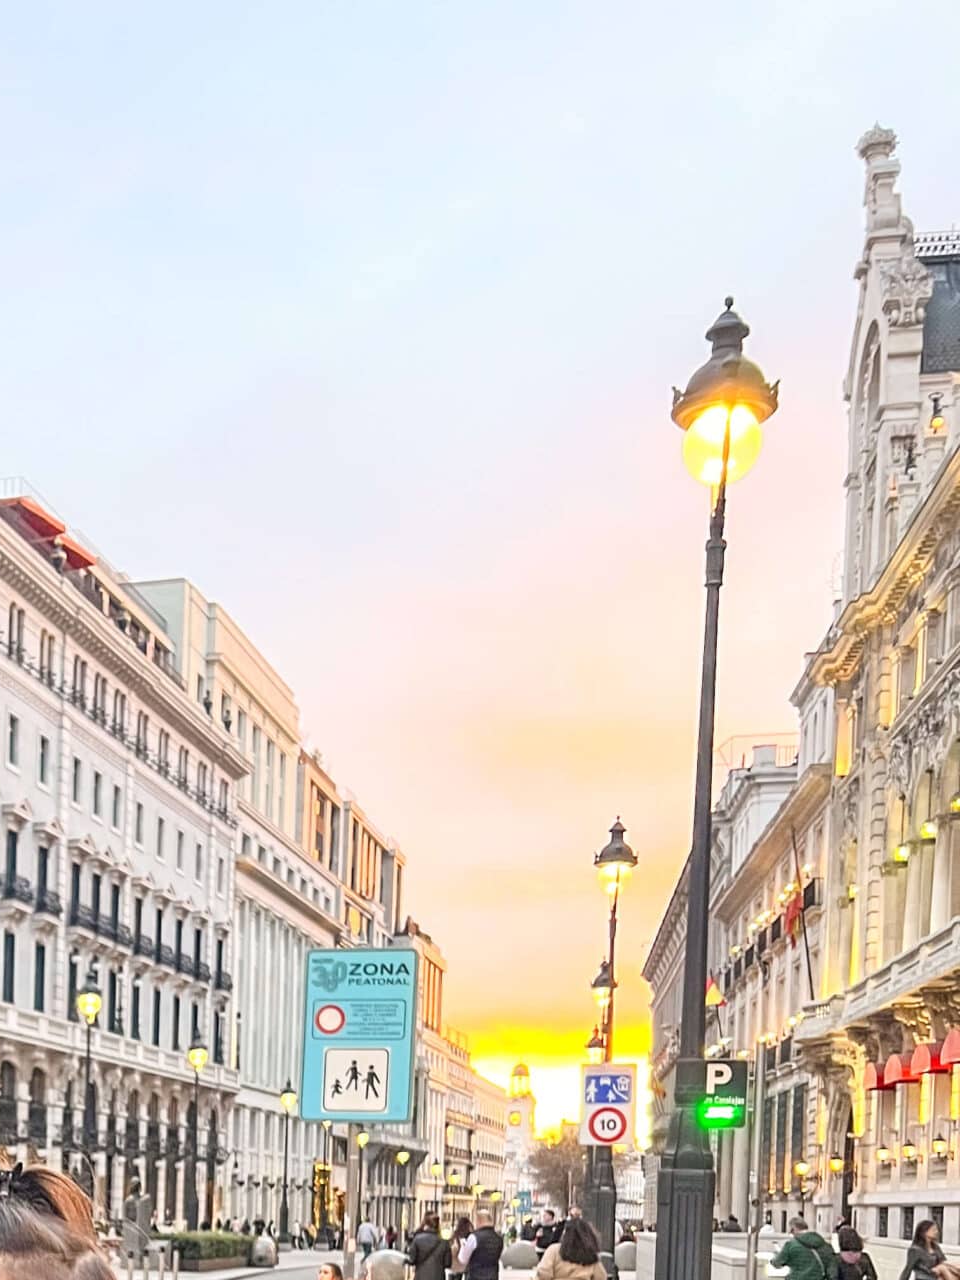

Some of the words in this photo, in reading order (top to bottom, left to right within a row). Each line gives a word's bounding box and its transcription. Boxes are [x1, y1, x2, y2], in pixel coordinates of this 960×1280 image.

[349, 963, 410, 976] ZONA
[348, 978, 409, 986] PEATONAL
[706, 1063, 732, 1094] P
[600, 1119, 617, 1131] 10
